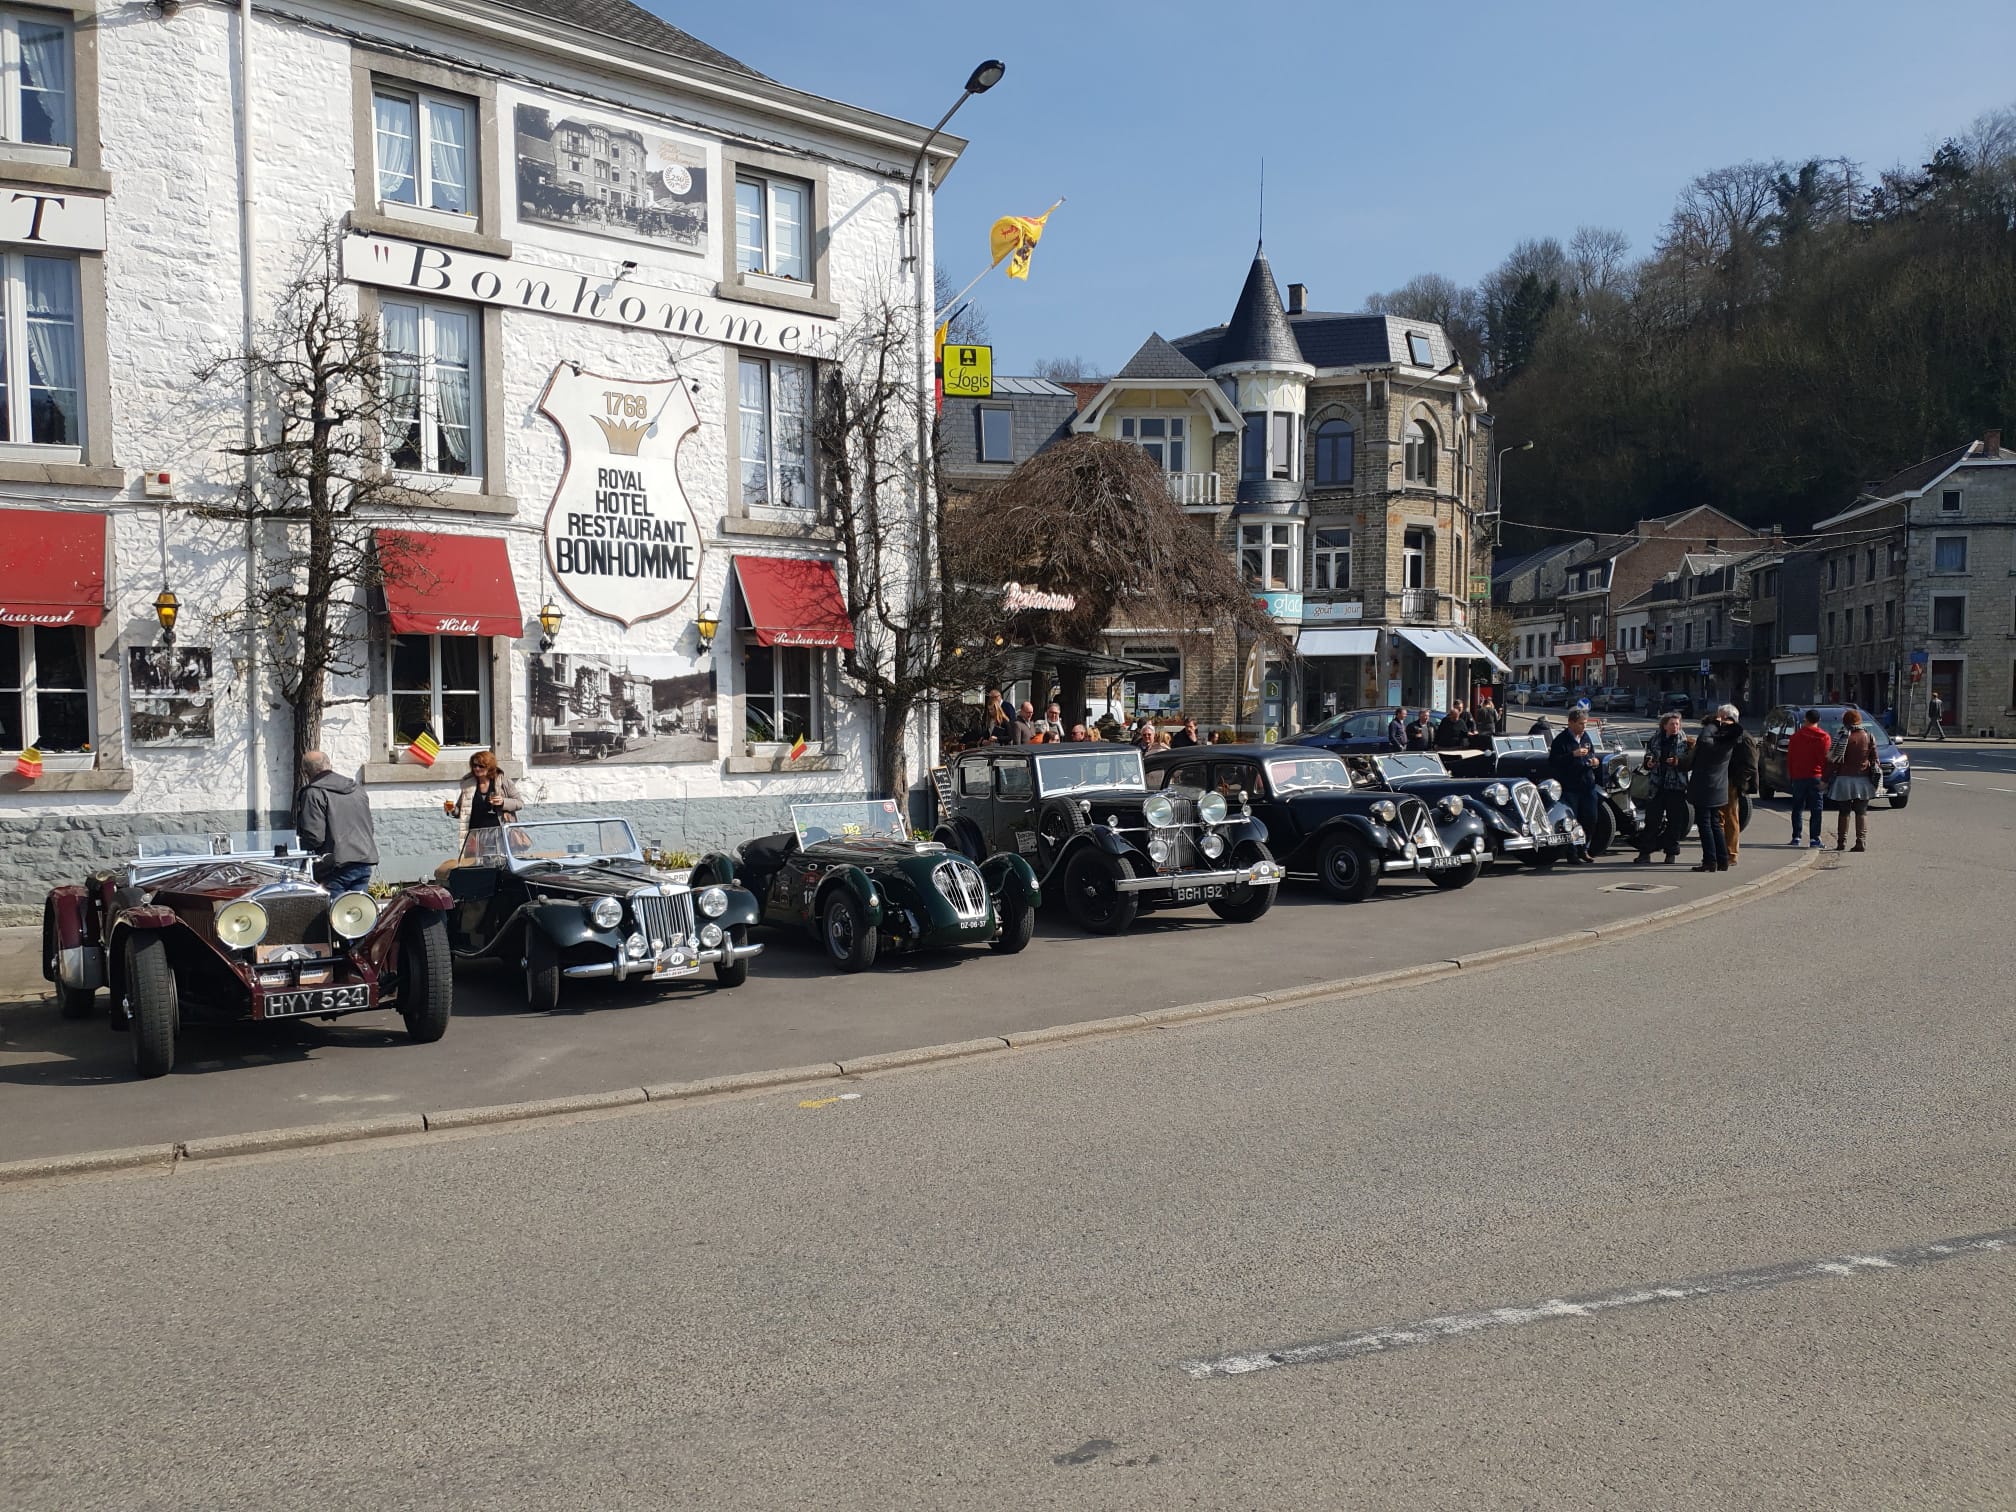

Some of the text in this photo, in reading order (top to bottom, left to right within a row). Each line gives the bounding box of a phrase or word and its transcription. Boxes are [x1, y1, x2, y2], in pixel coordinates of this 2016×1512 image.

[946, 366, 990, 393] Logis
[603, 391, 647, 419] 1768
[597, 467, 647, 492] ROYAL
[595, 490, 655, 518] HOTEL
[567, 512, 688, 544] RESTAURANT
[555, 536, 695, 581] BONHOMME
[436, 617, 480, 632] Hôtel
[1177, 885, 1223, 901] BGH 192
[269, 987, 365, 1015] HYY 524
